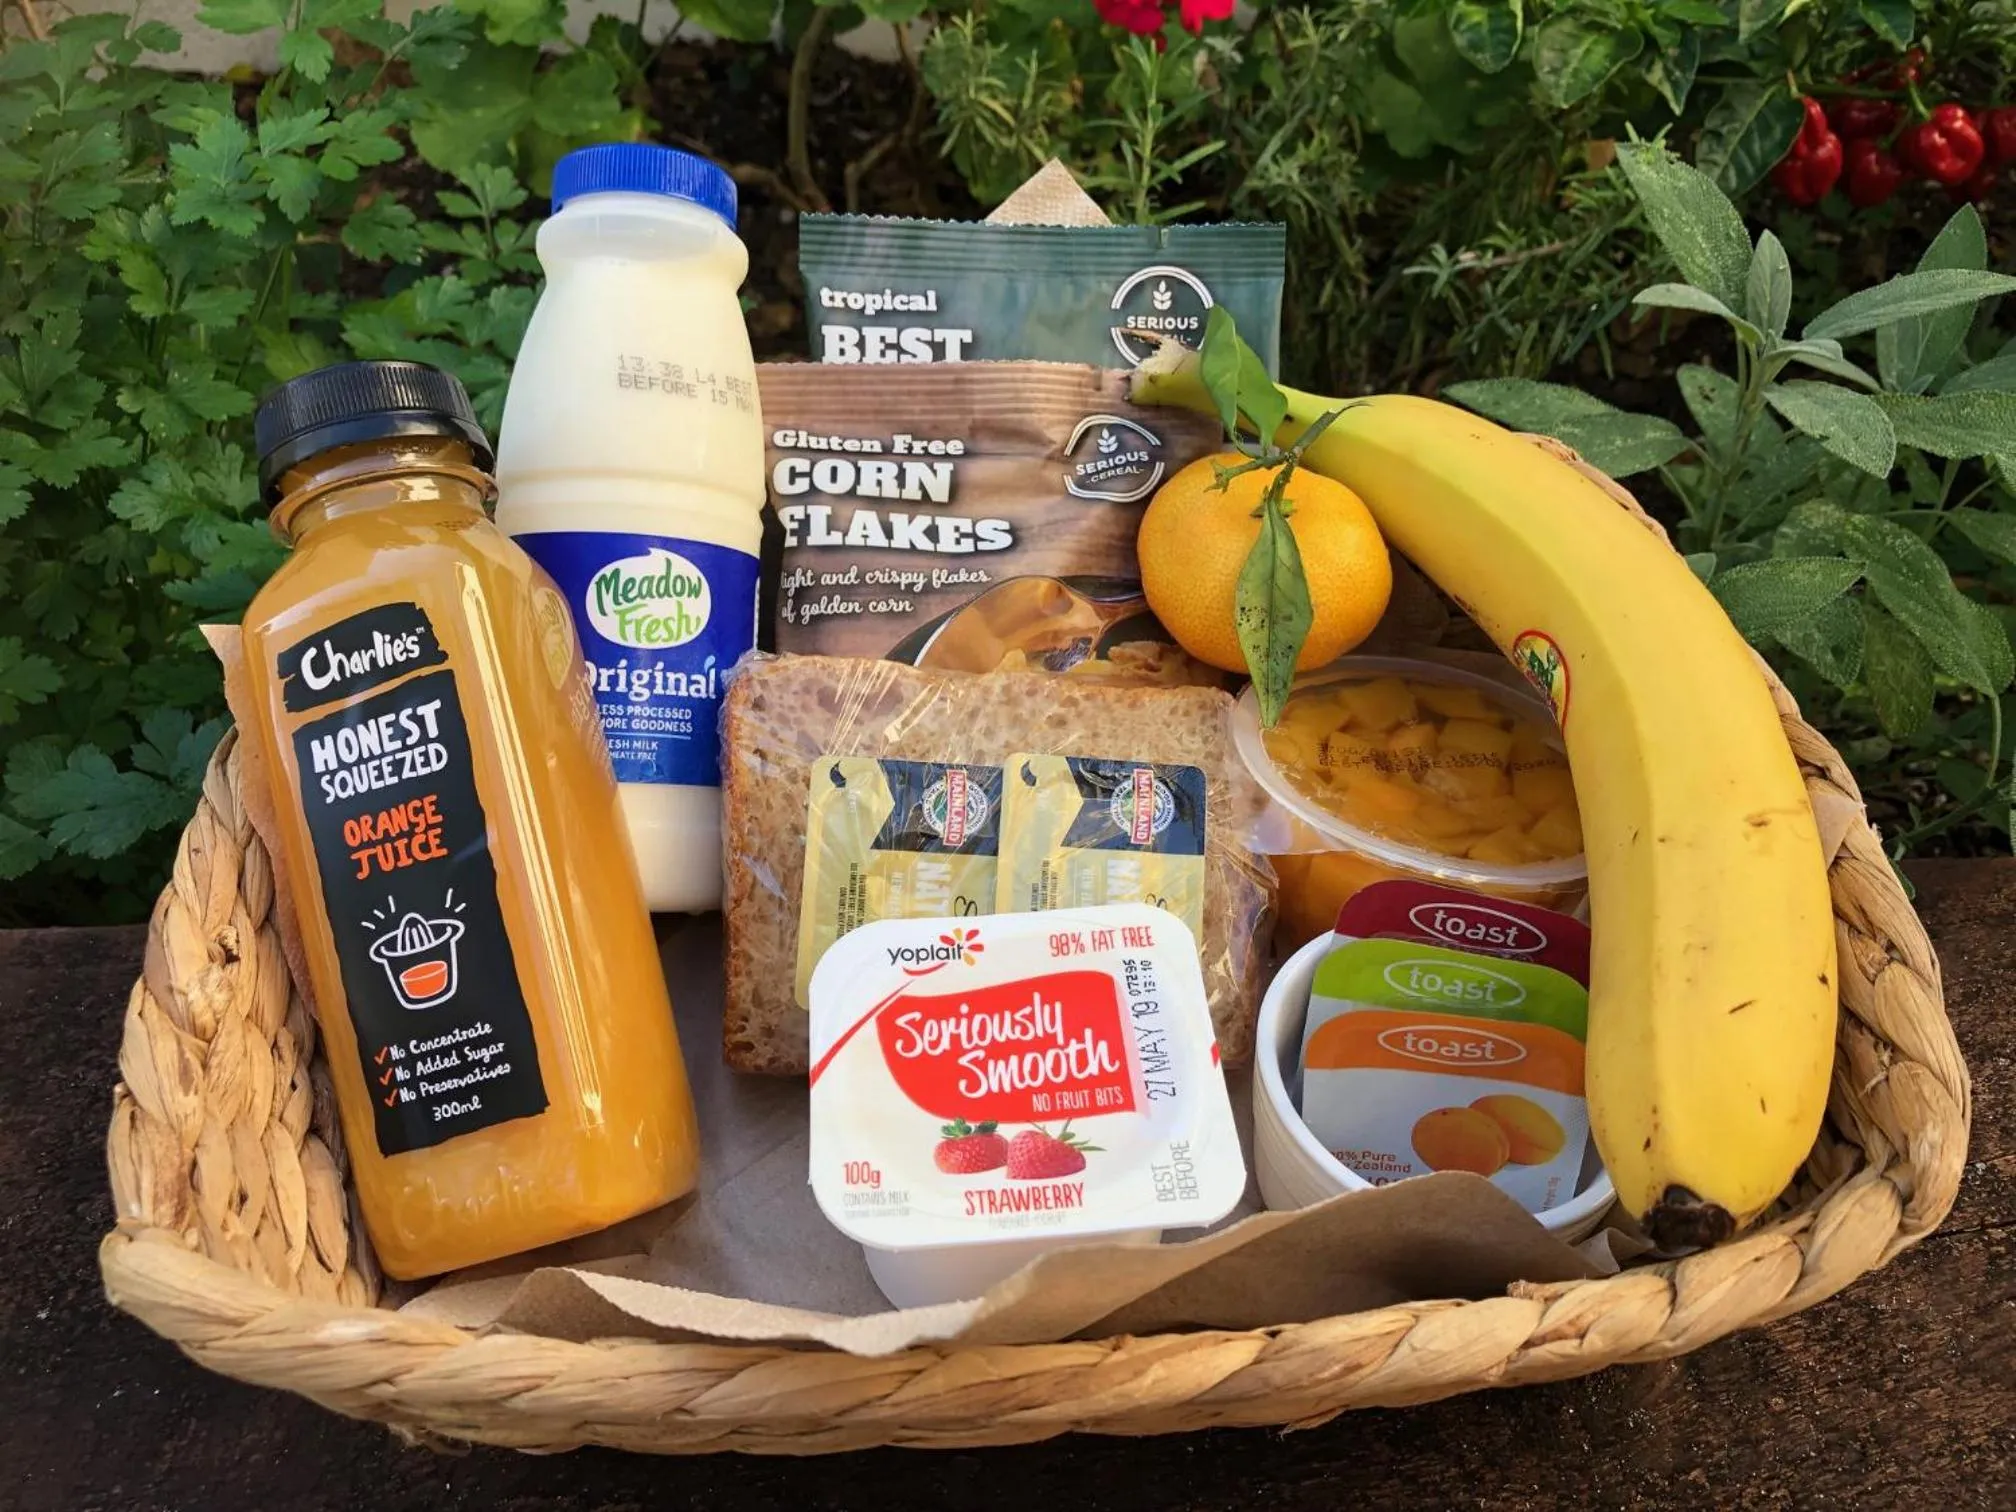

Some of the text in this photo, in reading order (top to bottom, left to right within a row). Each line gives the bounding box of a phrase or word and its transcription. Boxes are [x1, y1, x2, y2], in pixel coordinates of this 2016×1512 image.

[820, 286, 938, 315] tropical
[1126, 316, 1199, 330] SERIOUS
[820, 325, 973, 364] BEST
[617, 373, 698, 399] BEFORE
[773, 429, 965, 456] Gluten Free
[773, 458, 954, 503] CORN
[1075, 451, 1149, 476] SERIOUS
[779, 505, 1014, 554] FLAKES
[595, 557, 702, 617] Meadow
[821, 565, 860, 585] and
[865, 569, 928, 592] crispy
[931, 567, 991, 589] flakes
[614, 600, 701, 644] Fresh
[781, 595, 914, 624] of golden corn
[627, 705, 692, 720] PROCESSED
[631, 719, 693, 733] GOODNESS
[311, 700, 441, 774] HONEST
[608, 739, 659, 750] ESH MILK
[320, 743, 448, 804] SQUEEZED
[343, 795, 444, 847] ORANGE
[948, 772, 966, 840] MAINLAND
[1136, 774, 1151, 840] MAINLAND
[351, 828, 448, 880] JUICE
[1049, 926, 1155, 958] 98% FAT FREE
[1434, 909, 1519, 948] toast
[888, 936, 965, 967] yoplait
[1409, 965, 1497, 1001] toast
[389, 1021, 493, 1062] No Concentrate
[895, 992, 1063, 1059] Seriously
[395, 1041, 505, 1082] No Added Sugar
[958, 1029, 1120, 1099] Smooth
[1131, 1000, 1177, 1101] 27 MAY 19
[1404, 1031, 1496, 1060] toast
[399, 1063, 512, 1103] No Preservatives
[1032, 1086, 1125, 1113] NO FRUIT BITS
[432, 1095, 482, 1122] 300ml
[843, 1161, 881, 1189] 100g
[1170, 1140, 1199, 1201] BEFORE
[1353, 1160, 1413, 1174] Zealand
[1362, 1151, 1397, 1162] Pure
[964, 1182, 1084, 1216] STRAWBERRY
[1152, 1164, 1177, 1202] BEST
